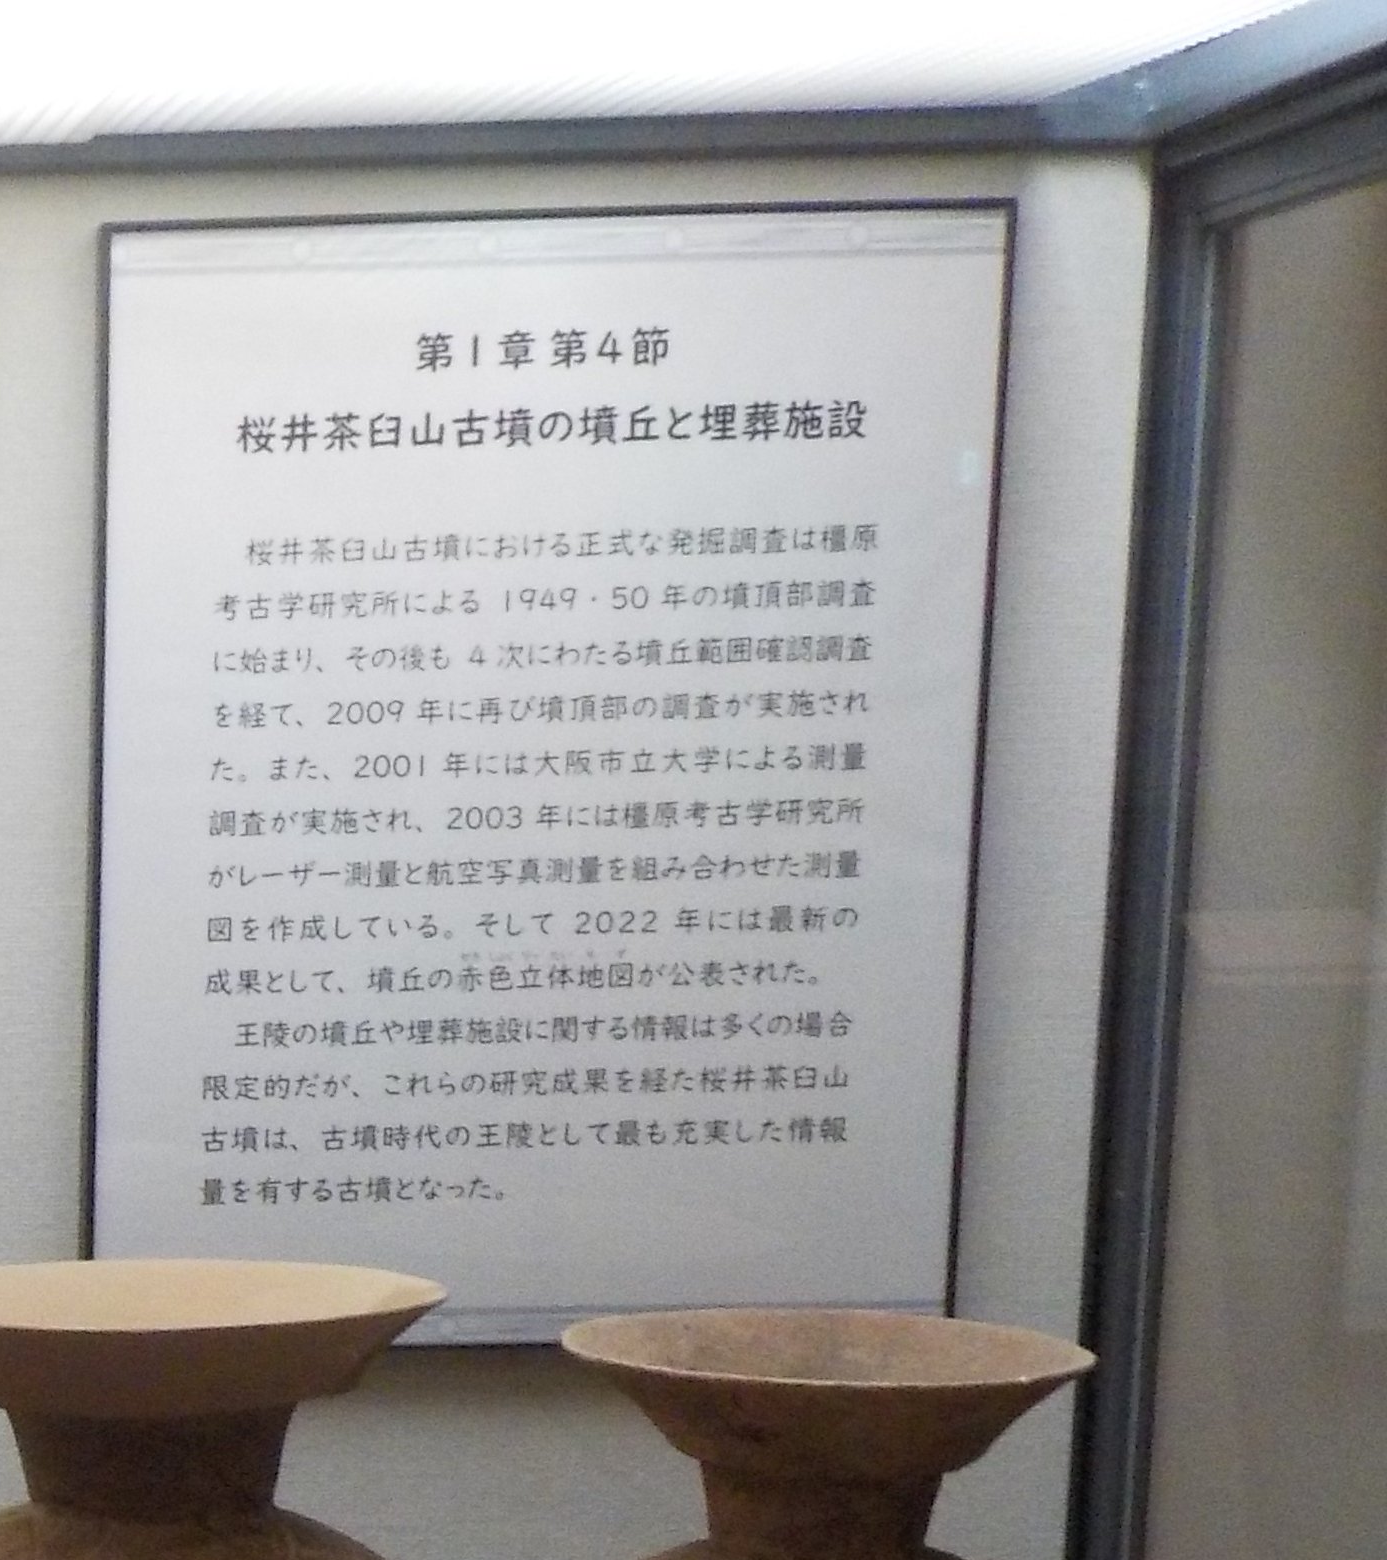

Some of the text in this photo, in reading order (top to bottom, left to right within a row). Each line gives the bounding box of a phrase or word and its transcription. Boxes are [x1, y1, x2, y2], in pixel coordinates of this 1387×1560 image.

[236, 400, 867, 454] 桜井茶臼山古墳の墳丘と埋葬施設
[245, 524, 878, 566] 桜井茶臼山古墳における正式な発掘調査は橿原
[208, 849, 862, 888] がレーザー測量と航空写真測量を組み合わせた測量
[235, 1009, 854, 1049] 王陵の墳丘や埋葬施設に関する情報は多くの場合
[201, 1064, 849, 1101] 限定的だが、これらの研究成果を経た桜井茶臼山
[200, 1115, 848, 1154] 古墳は、古墳時代の王陵として最も充実した情報
[199, 1173, 505, 1207] 量を有する古墳となった。
